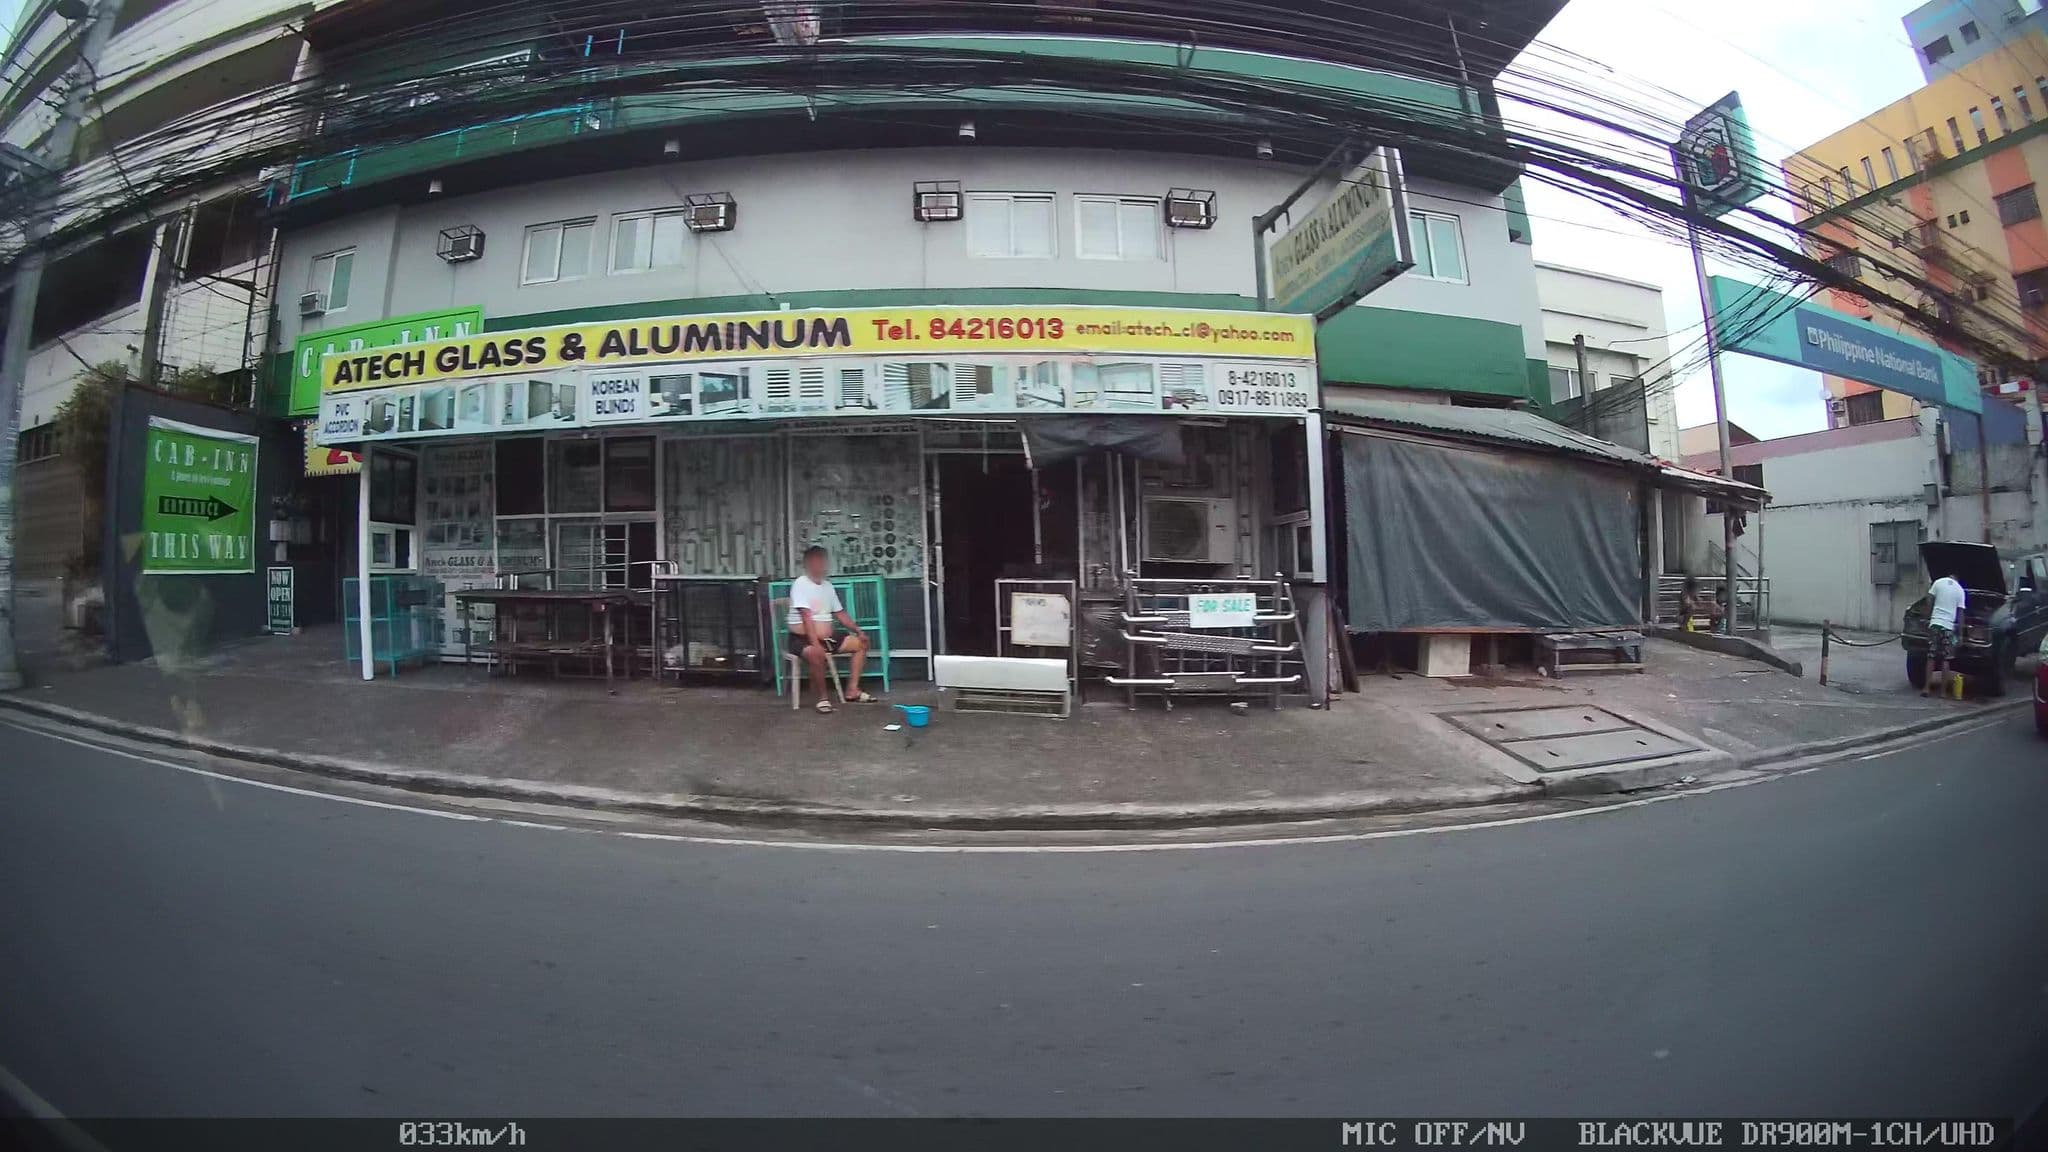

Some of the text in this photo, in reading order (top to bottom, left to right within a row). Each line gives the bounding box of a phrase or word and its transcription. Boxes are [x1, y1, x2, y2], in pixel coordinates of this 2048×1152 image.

[333, 350, 425, 386] ATECH
[435, 336, 546, 372] GLASS
[560, 332, 586, 362] &
[599, 317, 851, 358] ALUMINUM
[872, 319, 920, 341] Tel.
[929, 317, 1064, 340] 84216013
[1819, 328, 1940, 384] Philippine National Bank
[1228, 370, 1296, 387] 8-4216013
[591, 379, 640, 395] KOREAN
[335, 403, 350, 416] PVC
[596, 399, 635, 414] BLINDS
[151, 531, 248, 559] THIS WAY
[447, 555, 475, 568] GLASS
[271, 570, 291, 585] NOW
[270, 587, 291, 601] OPEN
[1222, 599, 1251, 612] SALE
